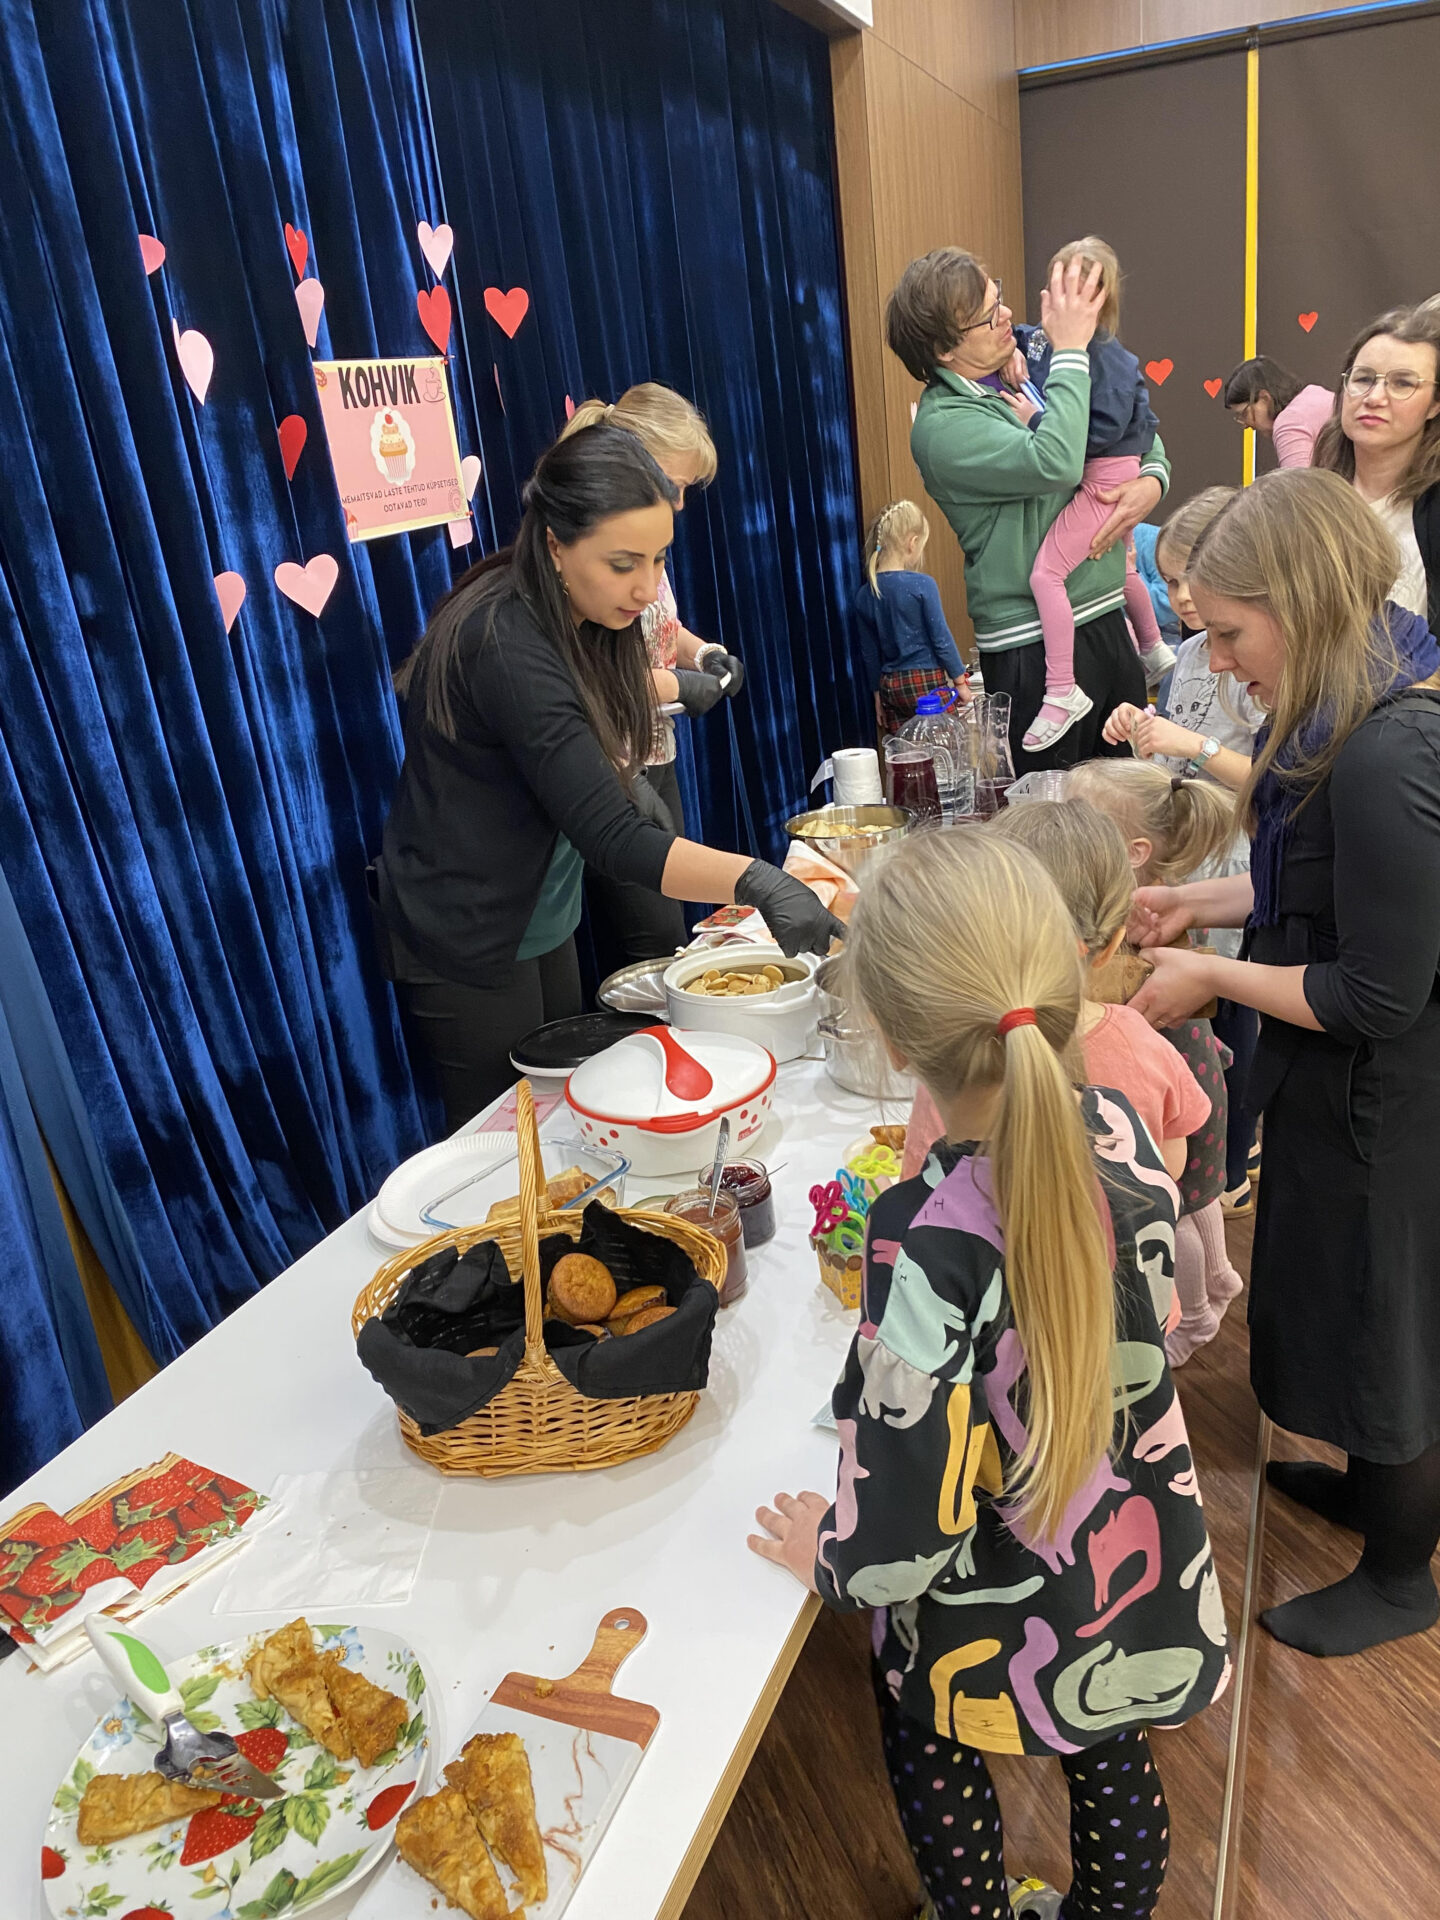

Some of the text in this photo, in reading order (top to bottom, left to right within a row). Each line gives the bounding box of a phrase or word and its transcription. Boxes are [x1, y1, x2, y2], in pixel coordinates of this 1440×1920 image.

[338, 365, 421, 409] KOHVIK
[384, 486, 402, 497] LASTE
[403, 483, 426, 494] TEHTUD
[384, 500, 413, 512] OOTAVAD
